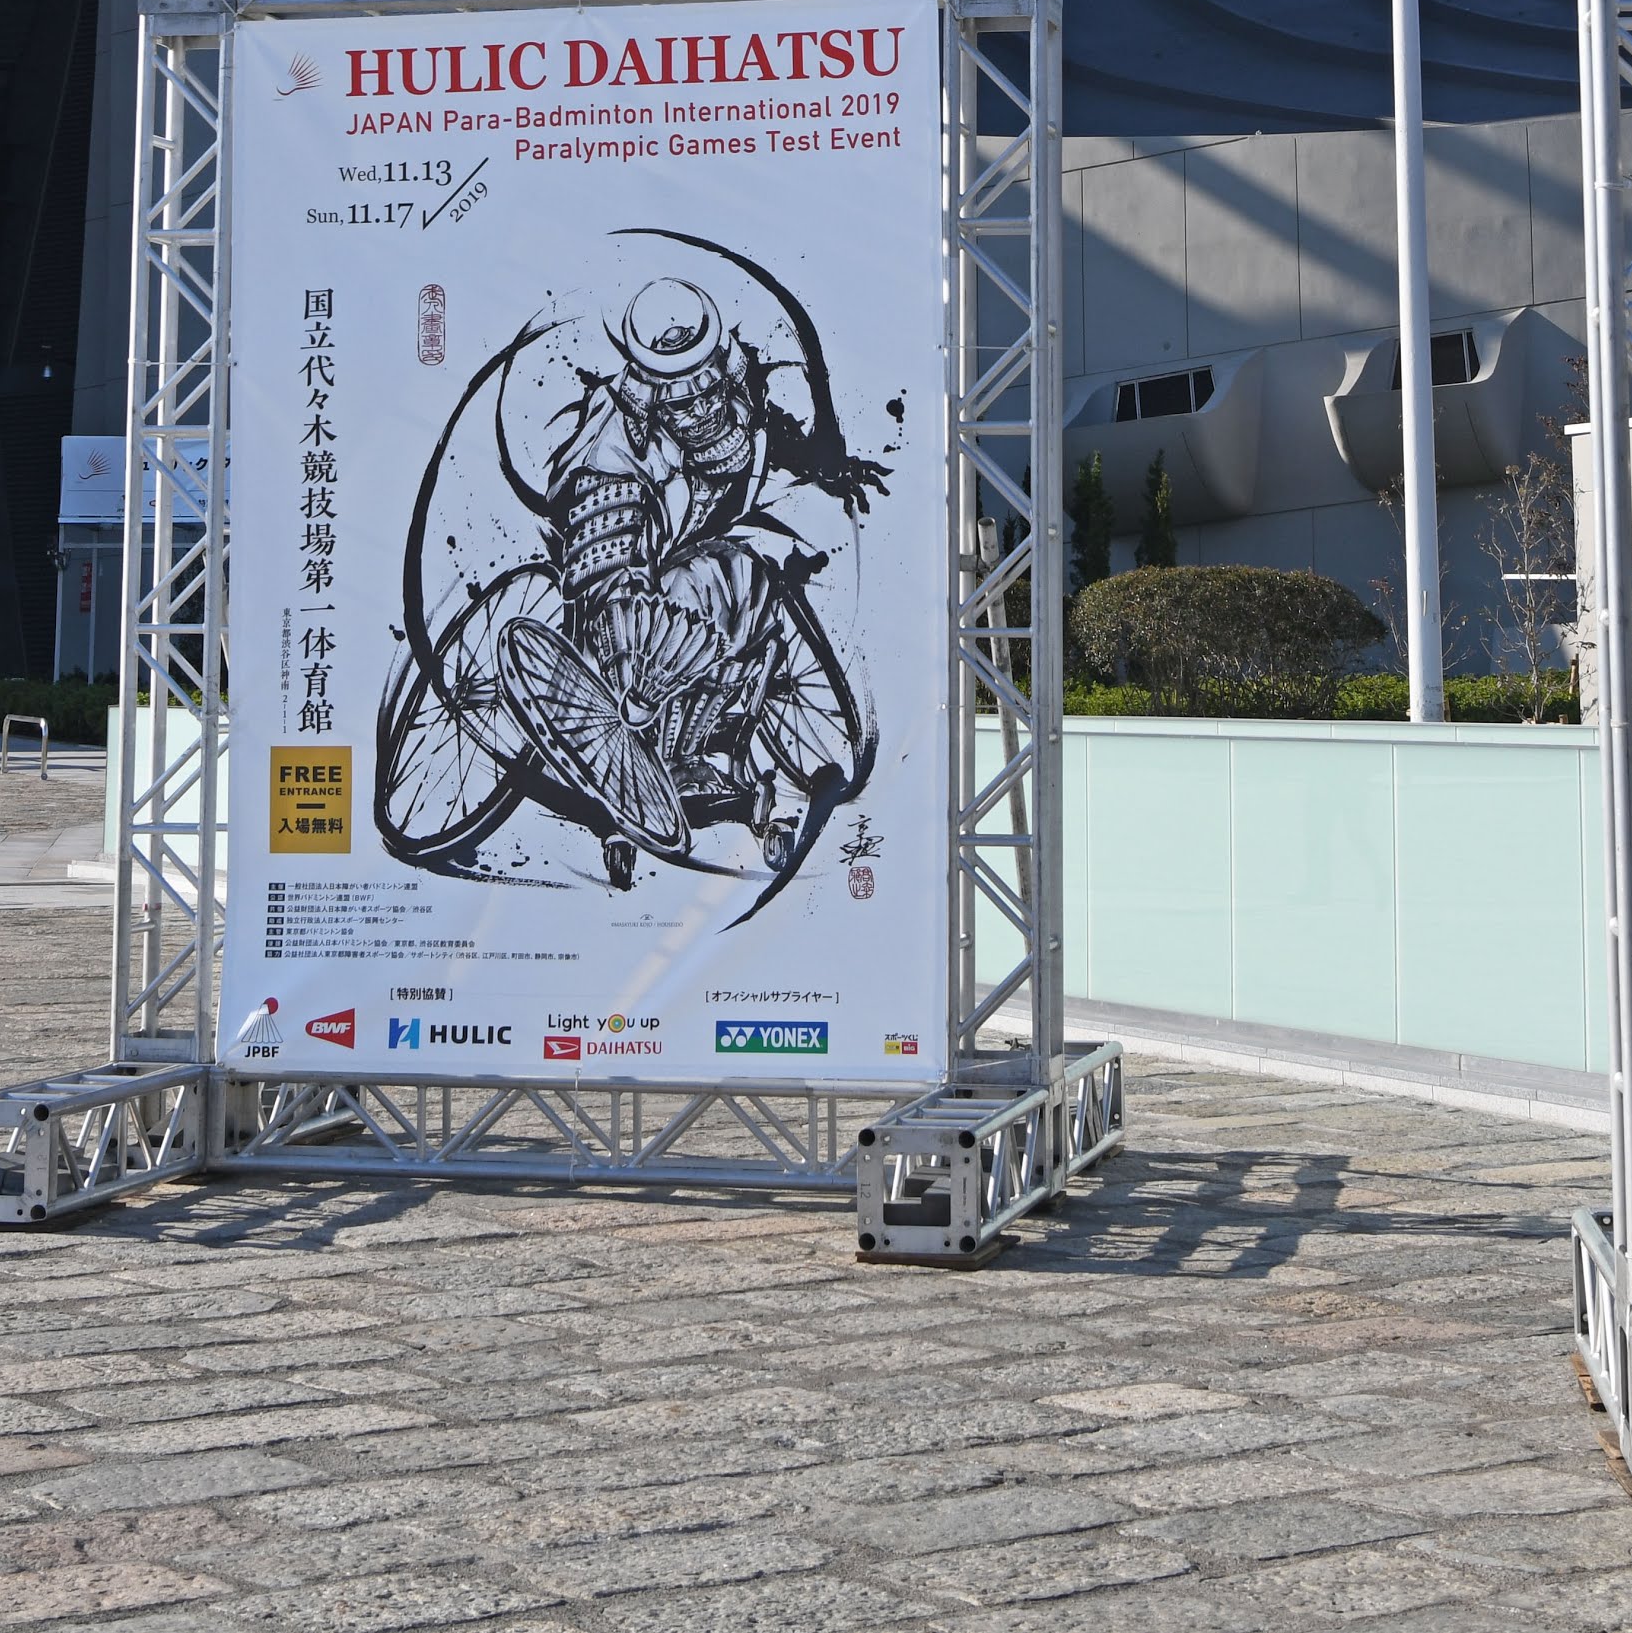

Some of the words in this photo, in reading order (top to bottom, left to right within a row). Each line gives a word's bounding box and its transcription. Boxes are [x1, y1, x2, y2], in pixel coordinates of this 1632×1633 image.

[344, 41, 547, 97] HULIC
[563, 27, 906, 88] DAIHATSU
[345, 110, 432, 136] JAPAN
[443, 103, 653, 132] Para-Badminton
[664, 95, 832, 124] International
[841, 91, 900, 117] 2019
[515, 134, 659, 164] Paralympic
[668, 133, 757, 156] Games
[765, 130, 820, 153] Test
[831, 126, 901, 150] Event
[450, 183, 489, 224] 2019
[296, 287, 338, 735] 国立代々木競技場第一体育館
[279, 765, 343, 785] FREE
[279, 787, 342, 796] ENTRANCE
[277, 817, 344, 835] 入場無料
[311, 1022, 352, 1035] BWF
[548, 1013, 590, 1032] Light
[640, 1017, 660, 1031] up
[429, 1024, 512, 1045] HULIC
[760, 1027, 821, 1048] YONEX
[244, 1045, 280, 1058] JPBF
[587, 1040, 662, 1055] DAIHATSU
